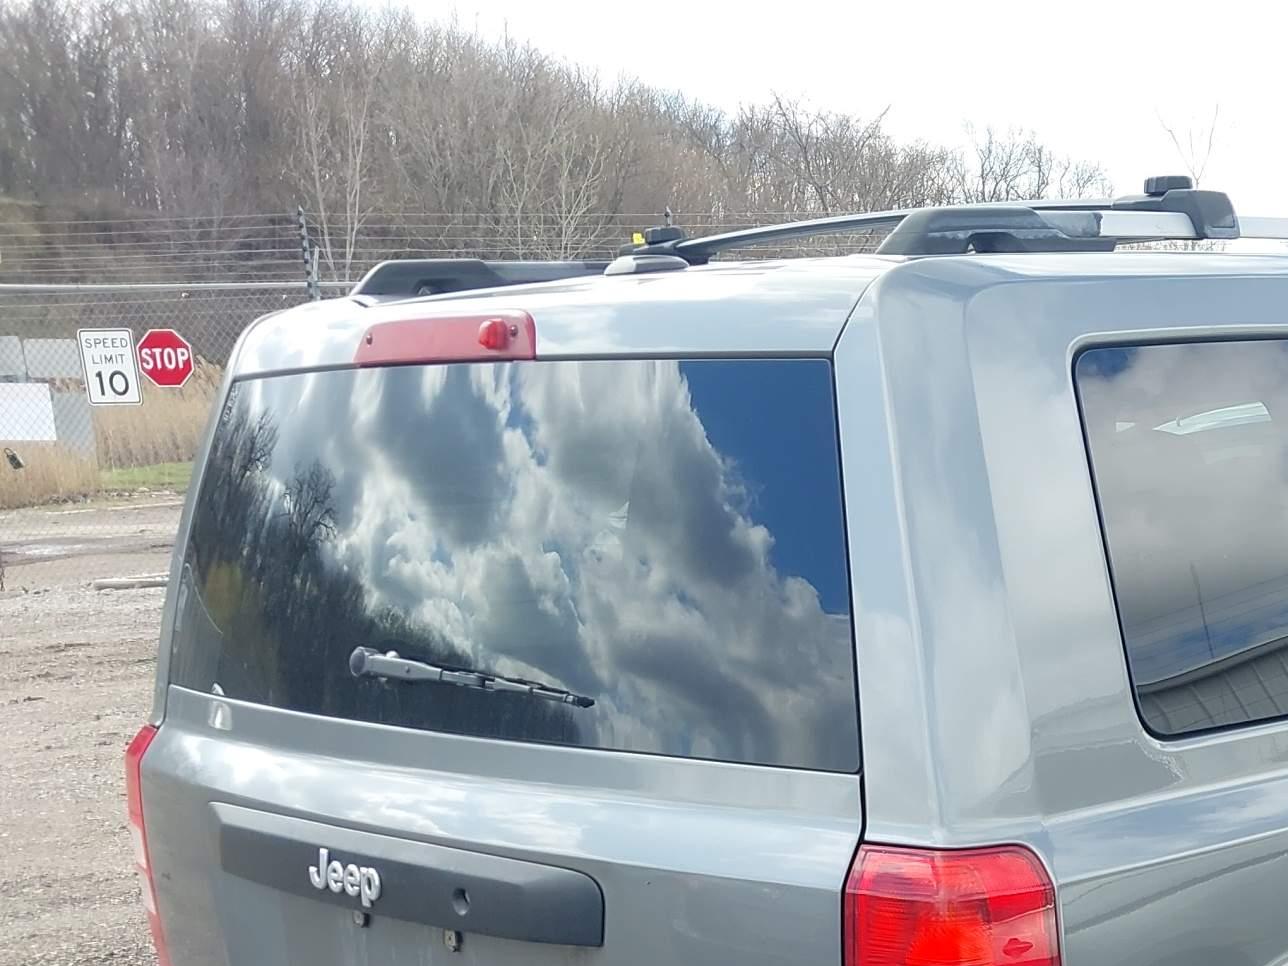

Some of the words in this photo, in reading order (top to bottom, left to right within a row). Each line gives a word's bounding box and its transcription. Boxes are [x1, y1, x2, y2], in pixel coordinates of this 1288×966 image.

[84, 337, 128, 349] SPEED
[91, 353, 126, 365] LIMIT
[141, 347, 189, 370] STOP
[95, 370, 130, 396] 10
[308, 847, 381, 908] Jeep
